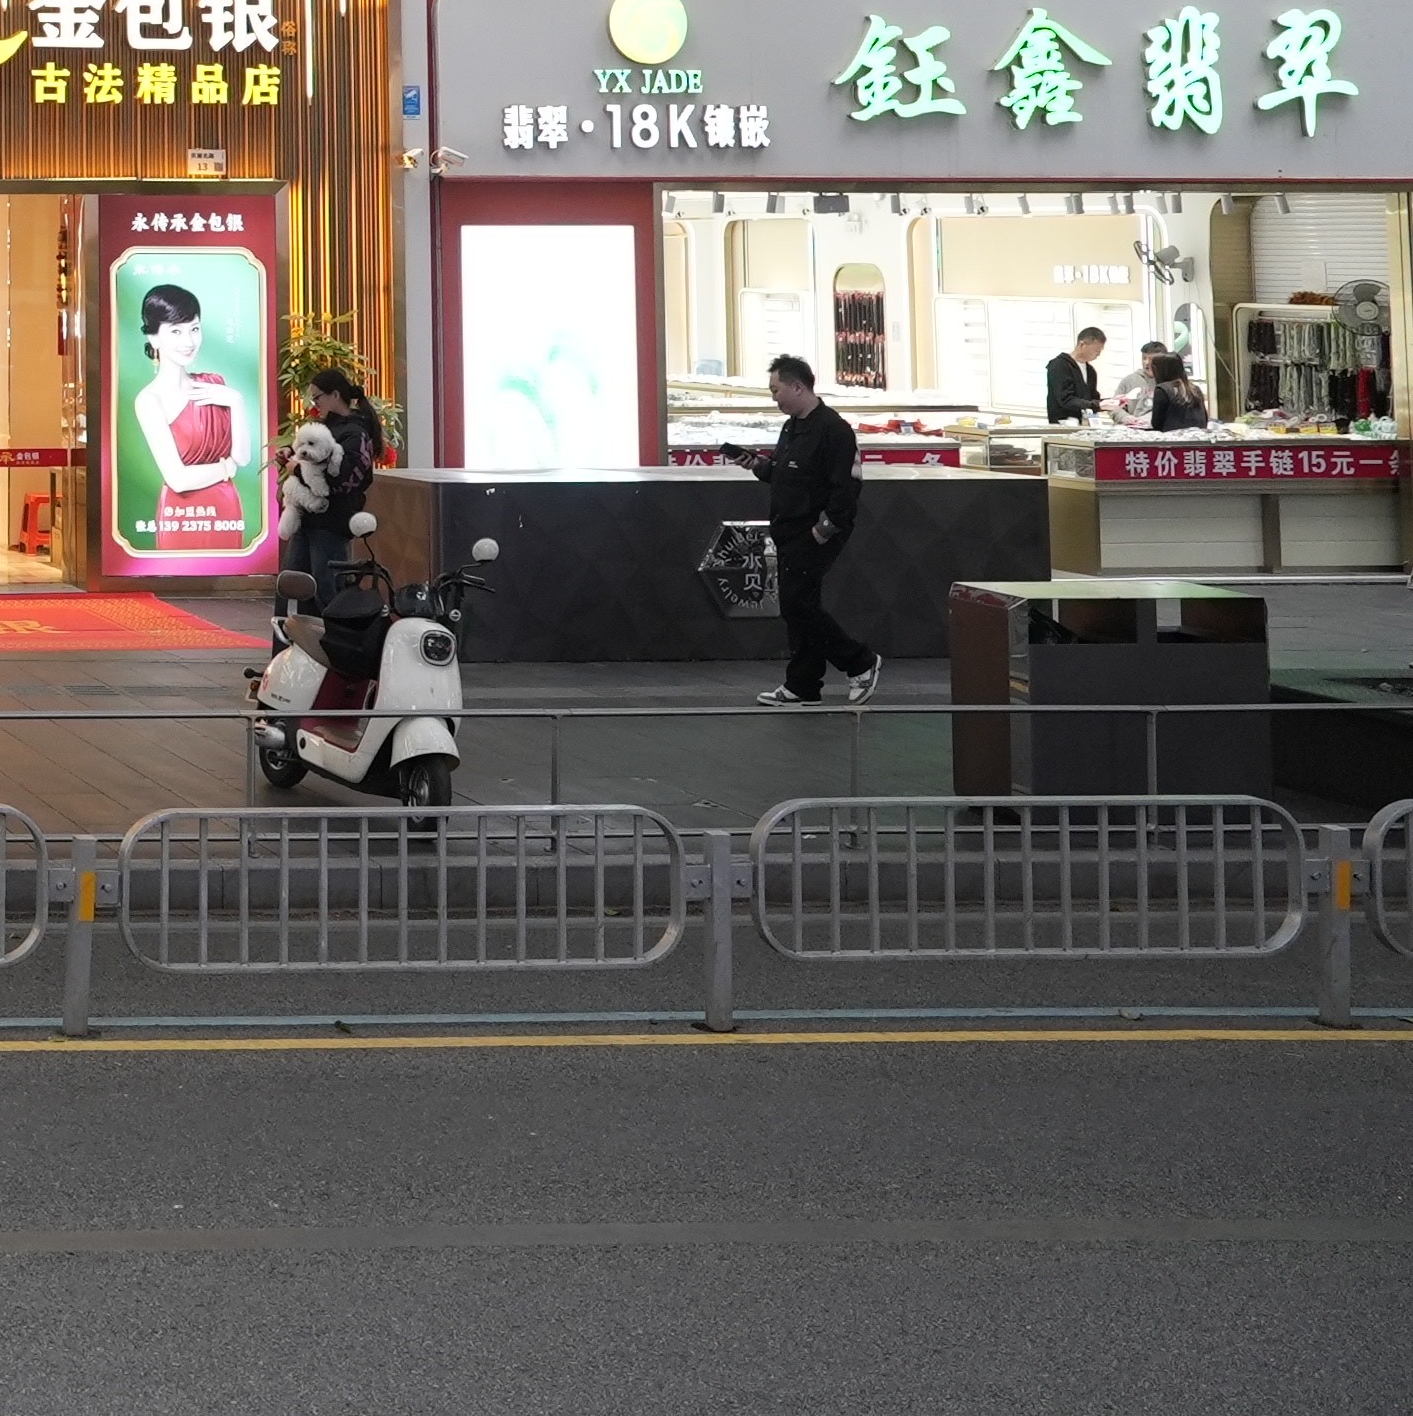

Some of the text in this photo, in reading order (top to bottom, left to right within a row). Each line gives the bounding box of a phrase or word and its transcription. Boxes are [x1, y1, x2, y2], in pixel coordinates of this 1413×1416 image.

[30, 61, 281, 106] 古法精品店
[594, 69, 703, 95] YX JADE
[198, 163, 208, 171] 13
[131, 212, 245, 232] 永传承金包银
[742, 553, 763, 591] 水贝
